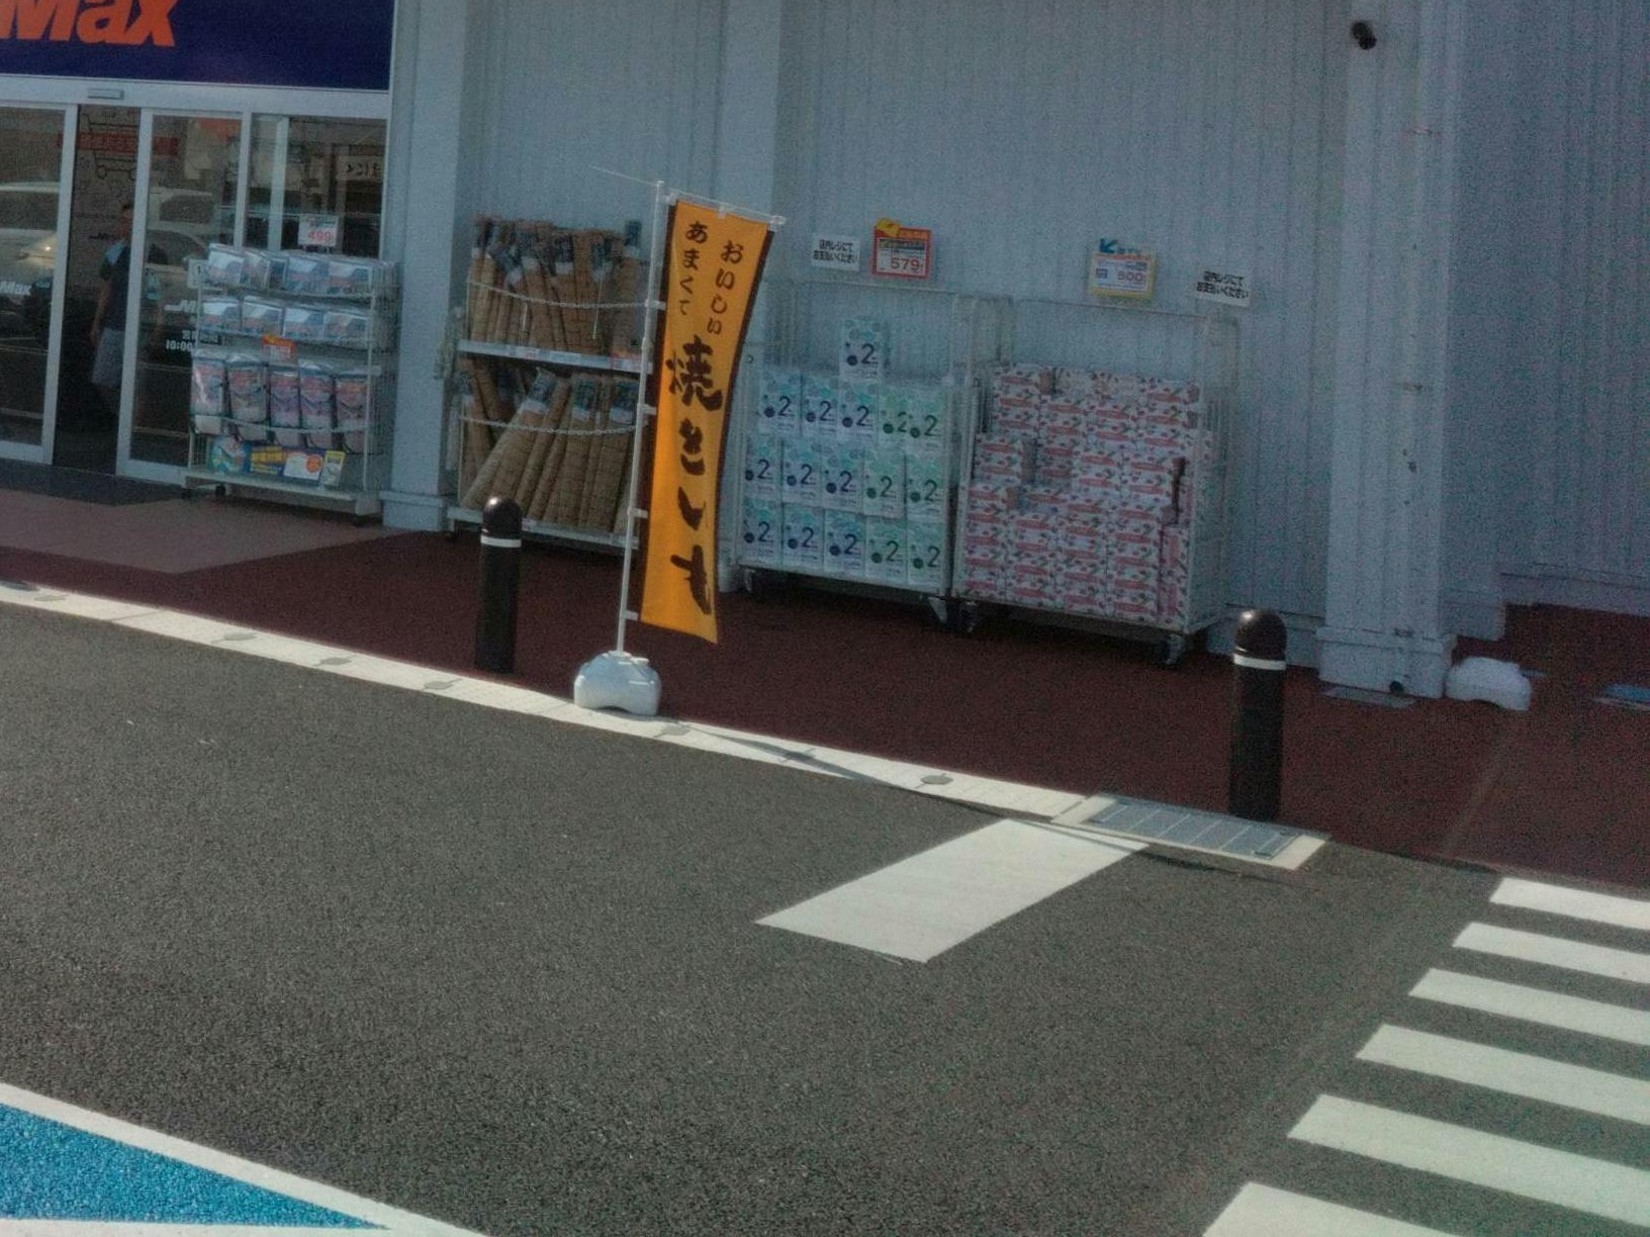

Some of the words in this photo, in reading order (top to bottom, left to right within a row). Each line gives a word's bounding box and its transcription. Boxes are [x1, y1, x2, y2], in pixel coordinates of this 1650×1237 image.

[679, 219, 708, 316] あまくて
[706, 239, 745, 337] おいしい
[891, 256, 921, 273] 579
[666, 335, 724, 616] 焼きいも
